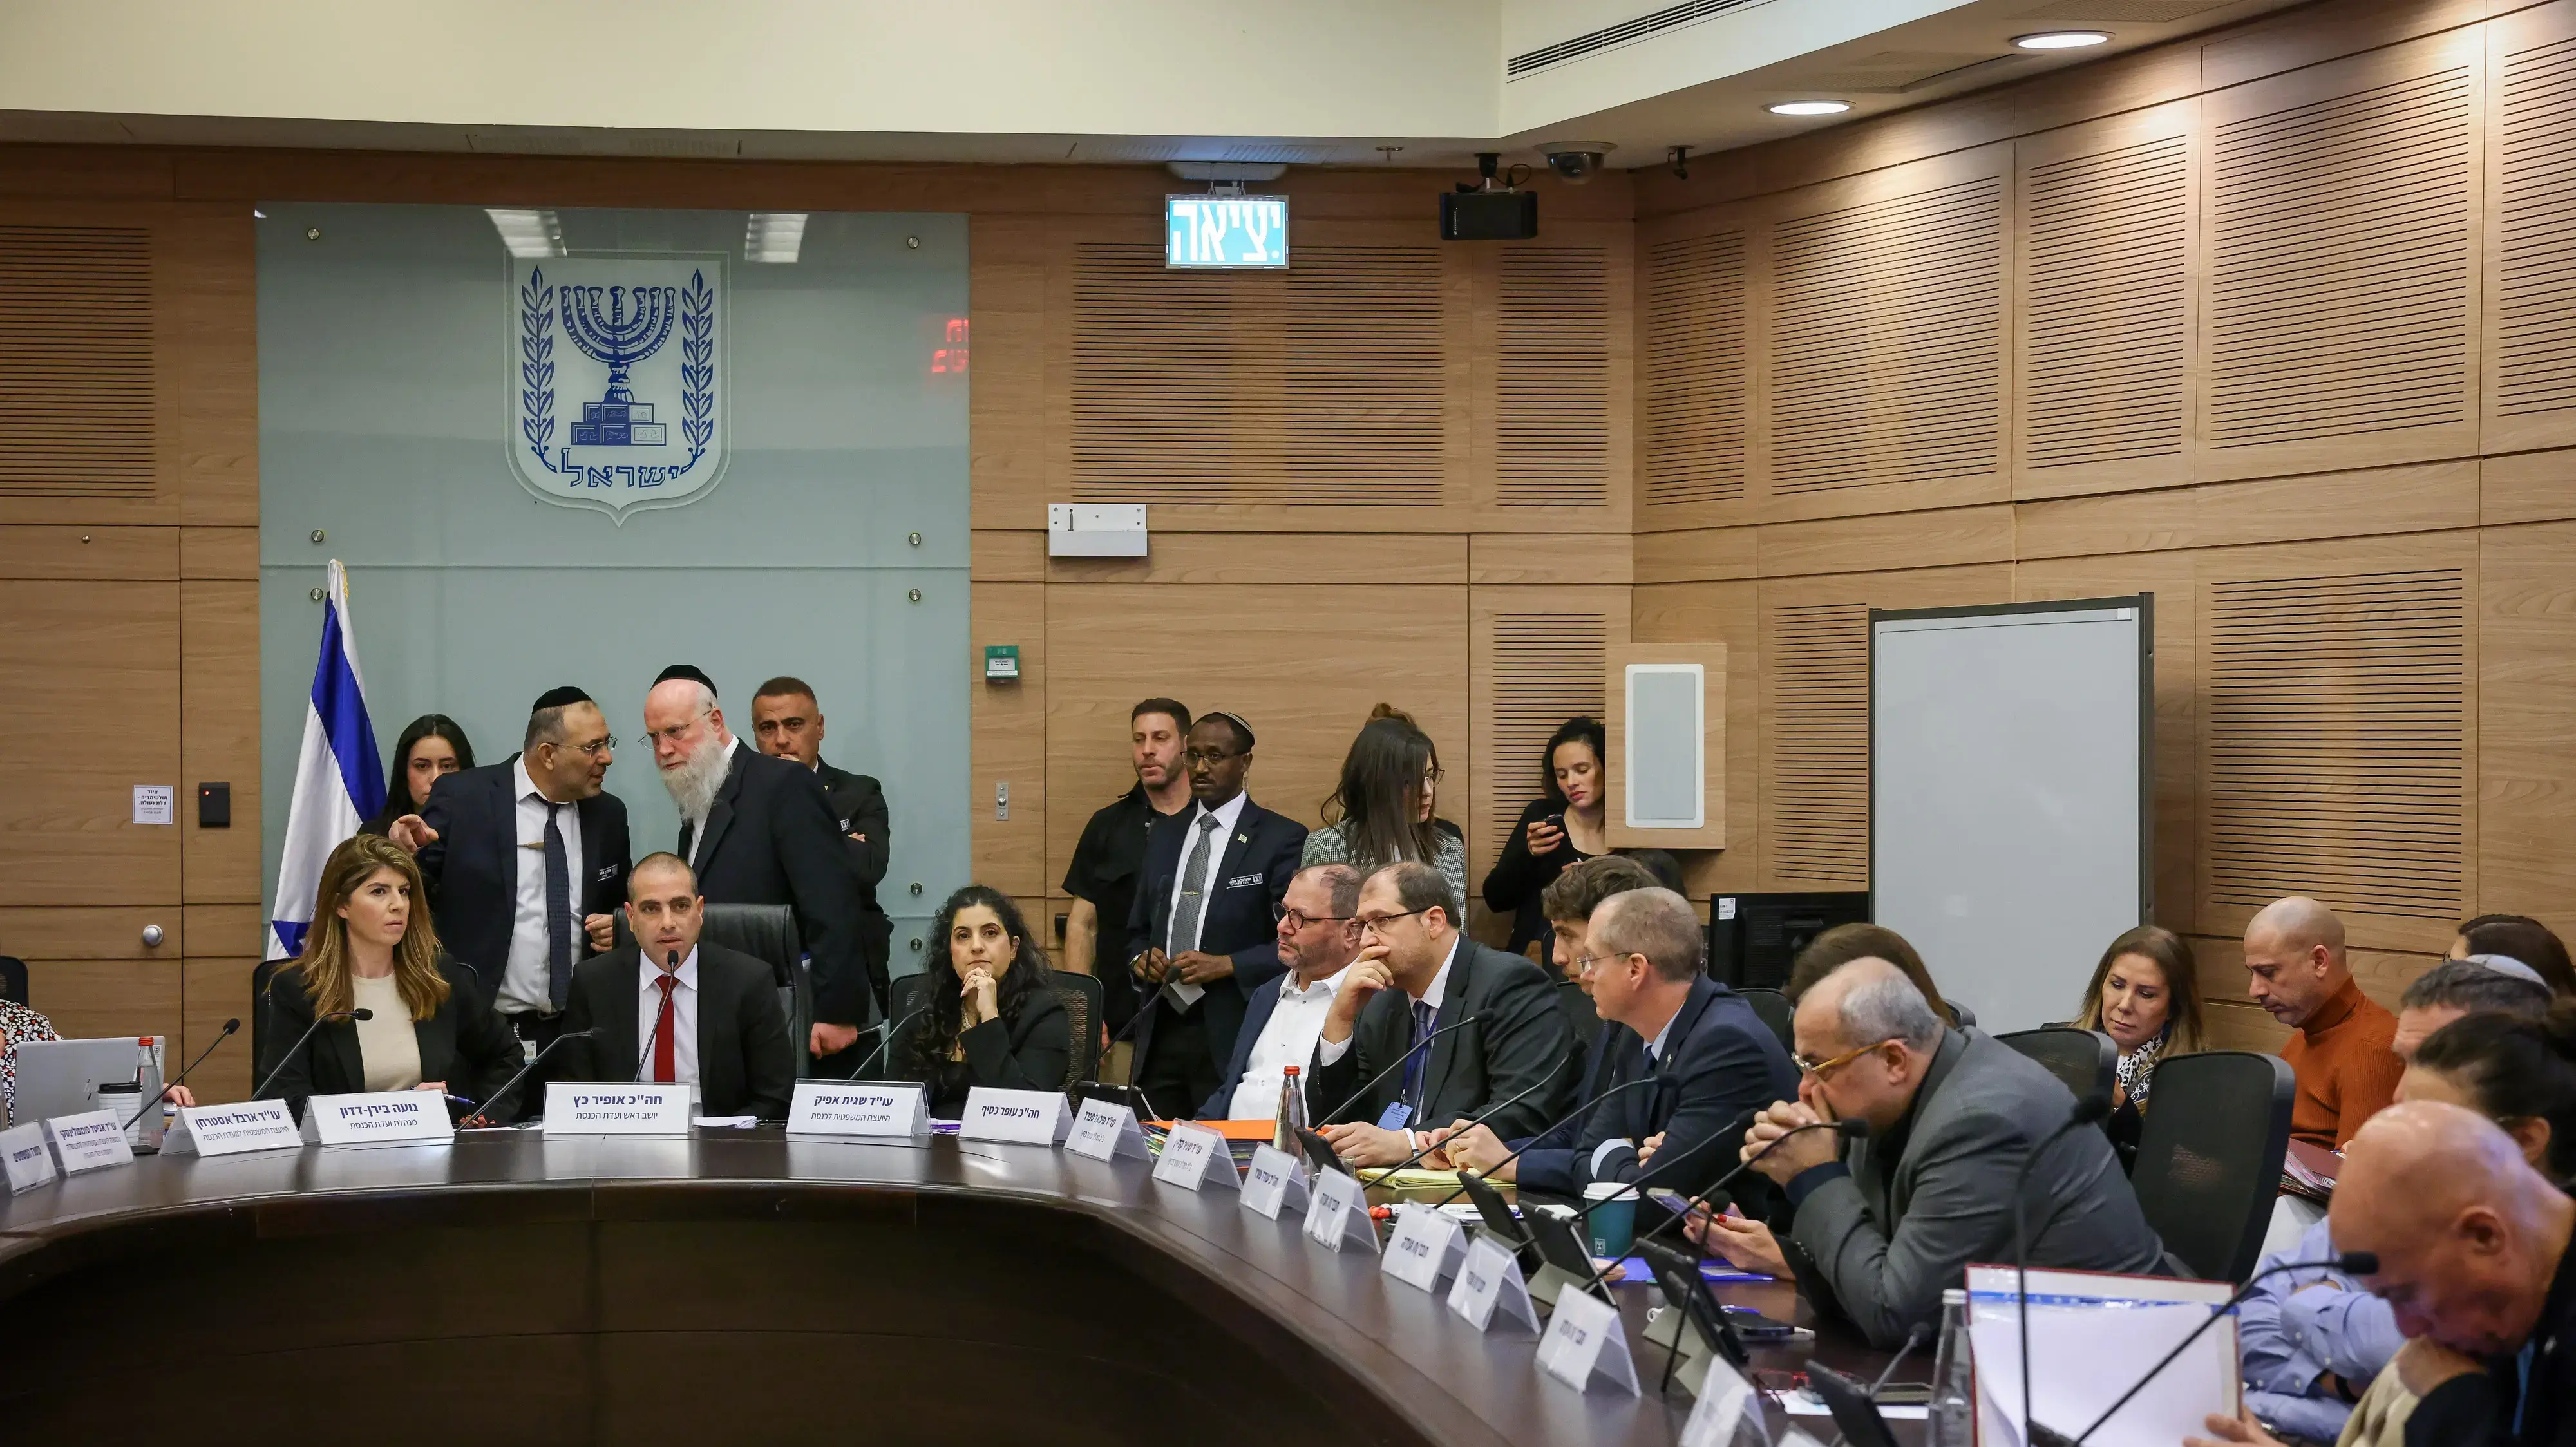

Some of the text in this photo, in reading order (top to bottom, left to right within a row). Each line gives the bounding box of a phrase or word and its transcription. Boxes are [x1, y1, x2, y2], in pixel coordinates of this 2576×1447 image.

[560, 448, 679, 488] ישראל
[573, 1094, 663, 1108] חה"כ אופיר כץ
[814, 1095, 893, 1106] עו"ד שגית אפיק
[339, 1102, 419, 1119] נועה בירן-דדון
[981, 1105, 1040, 1119] חה"כ עופר כסיף
[195, 1110, 281, 1130] עו"ד ארבל אסטרחן
[350, 1121, 374, 1130] הכנסת
[393, 1119, 418, 1127] מנהלת
[203, 1132, 223, 1141] הכנסת
[243, 1128, 270, 1136] המשפטית
